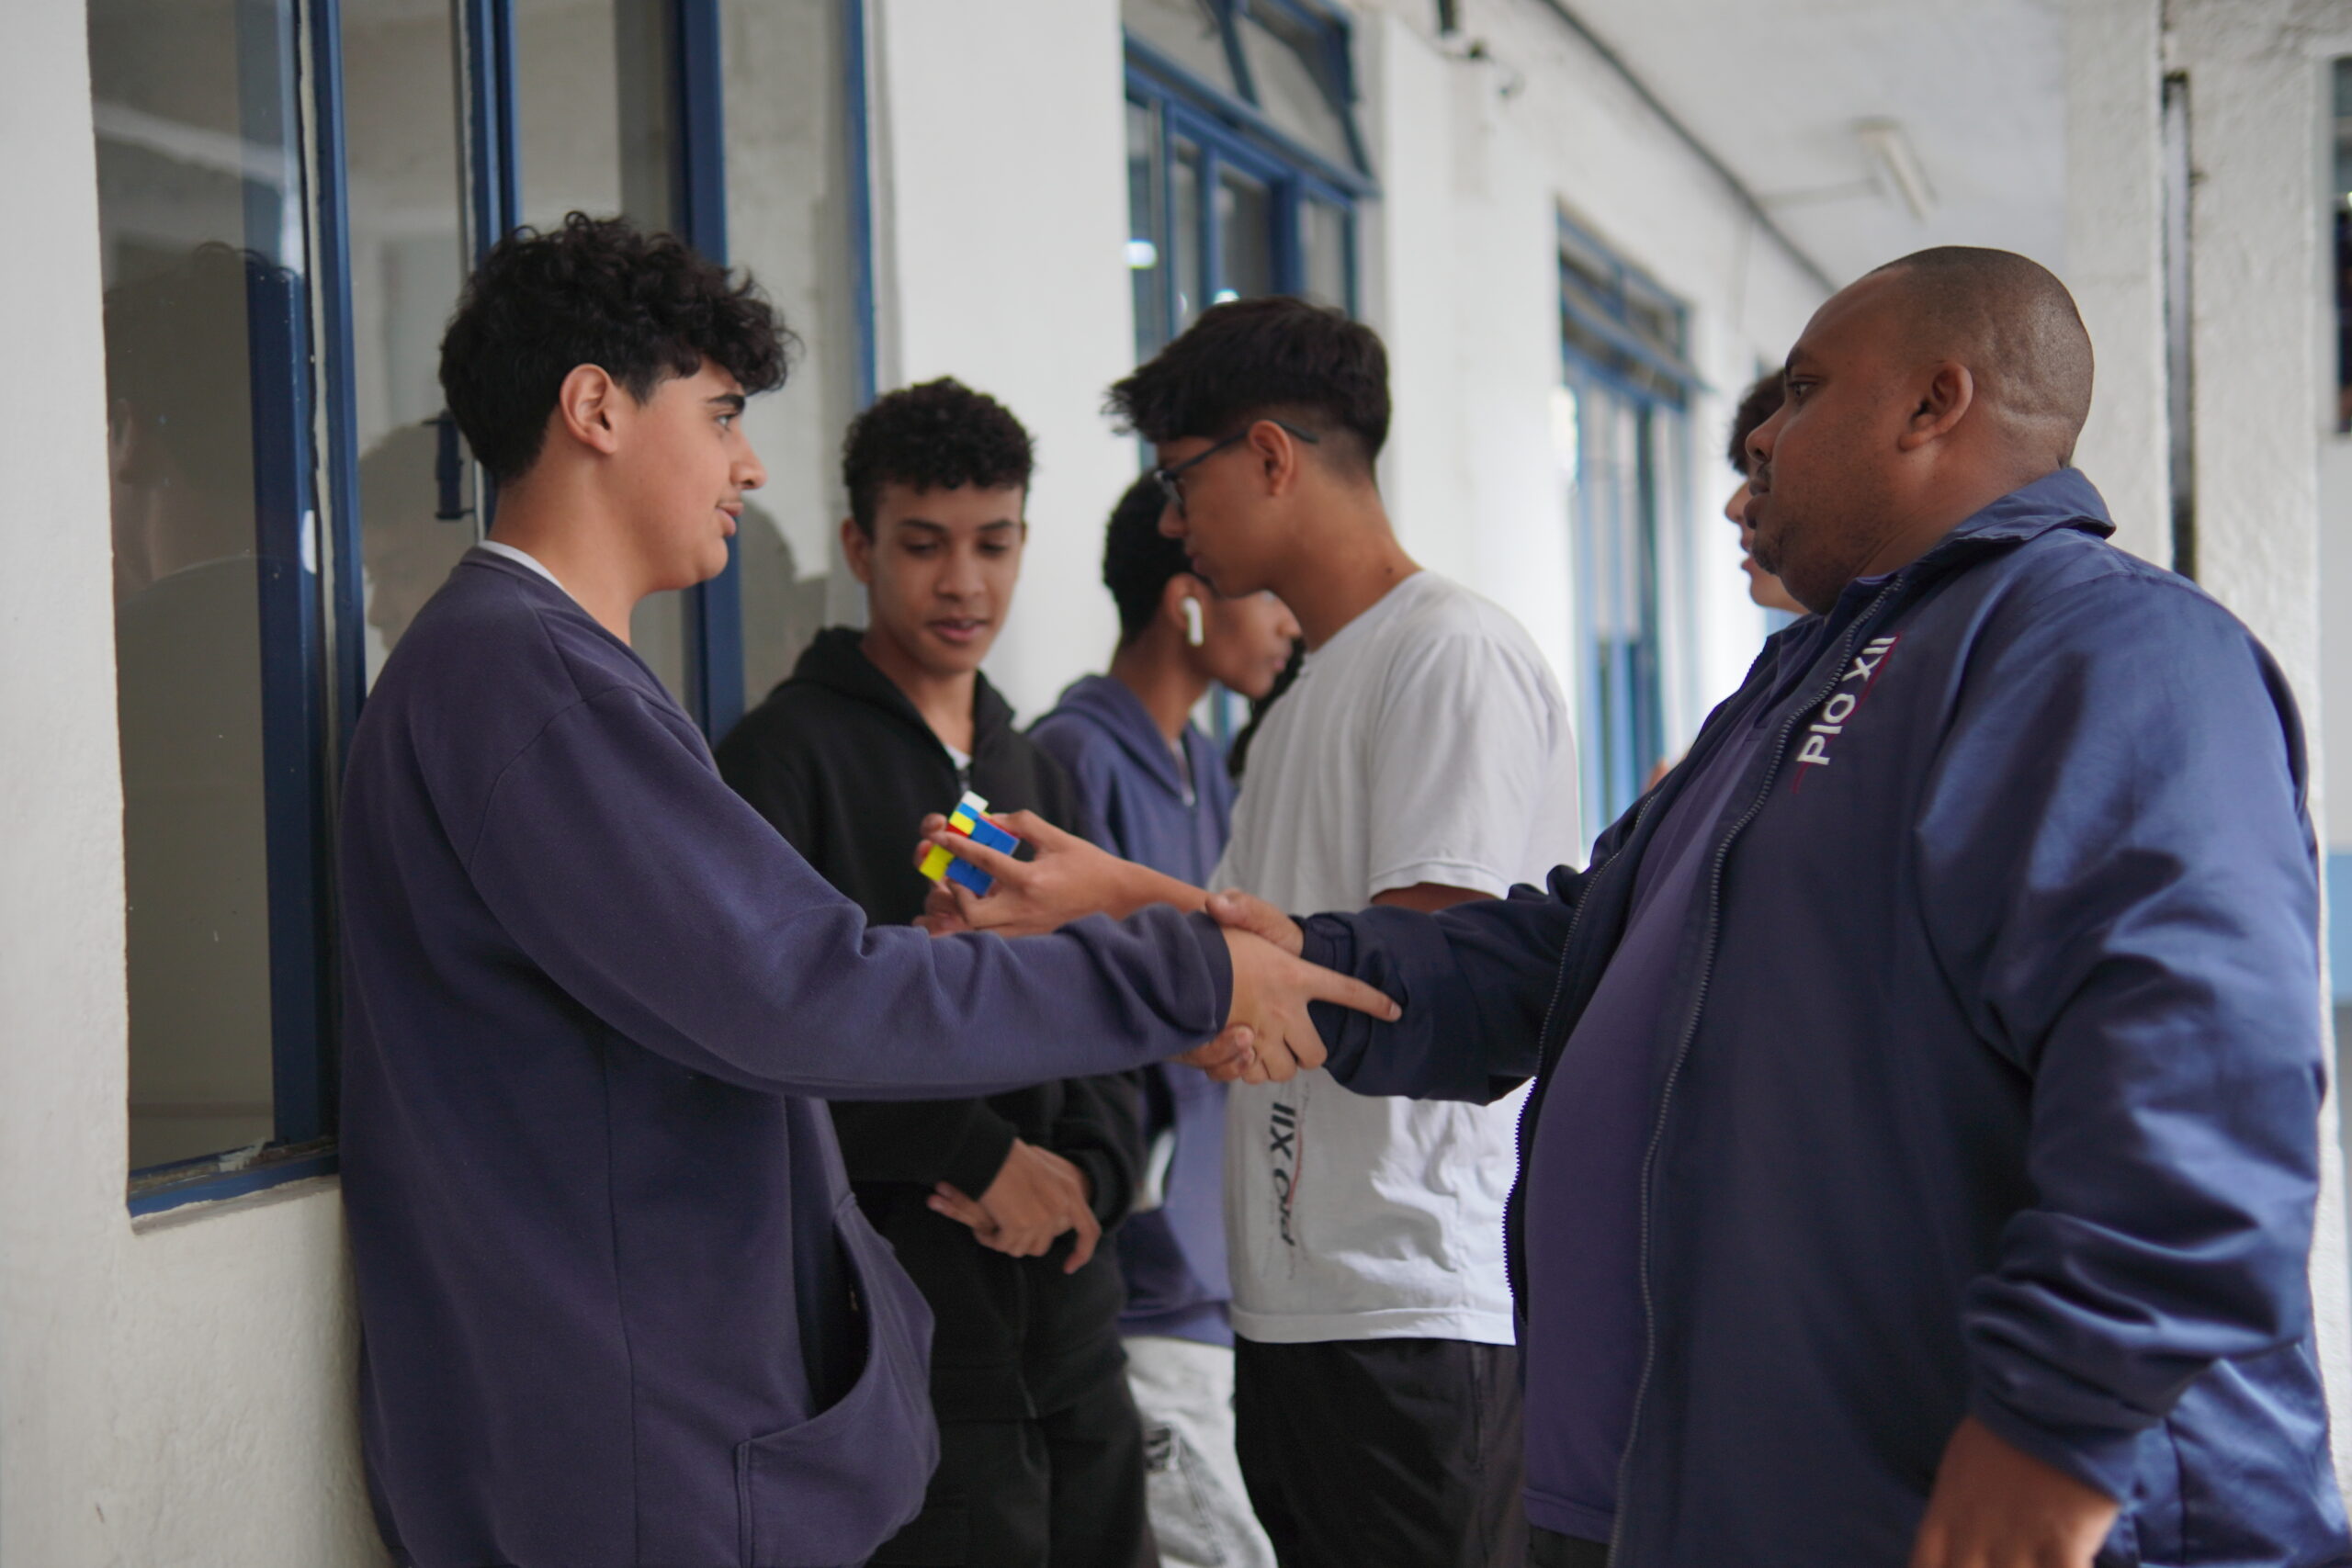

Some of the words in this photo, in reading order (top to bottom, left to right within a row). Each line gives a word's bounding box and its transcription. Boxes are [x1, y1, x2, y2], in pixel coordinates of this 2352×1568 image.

[1796, 693, 1856, 765] PIO
[1841, 636, 1897, 682] XII
[1270, 1102, 1296, 1160] XII
